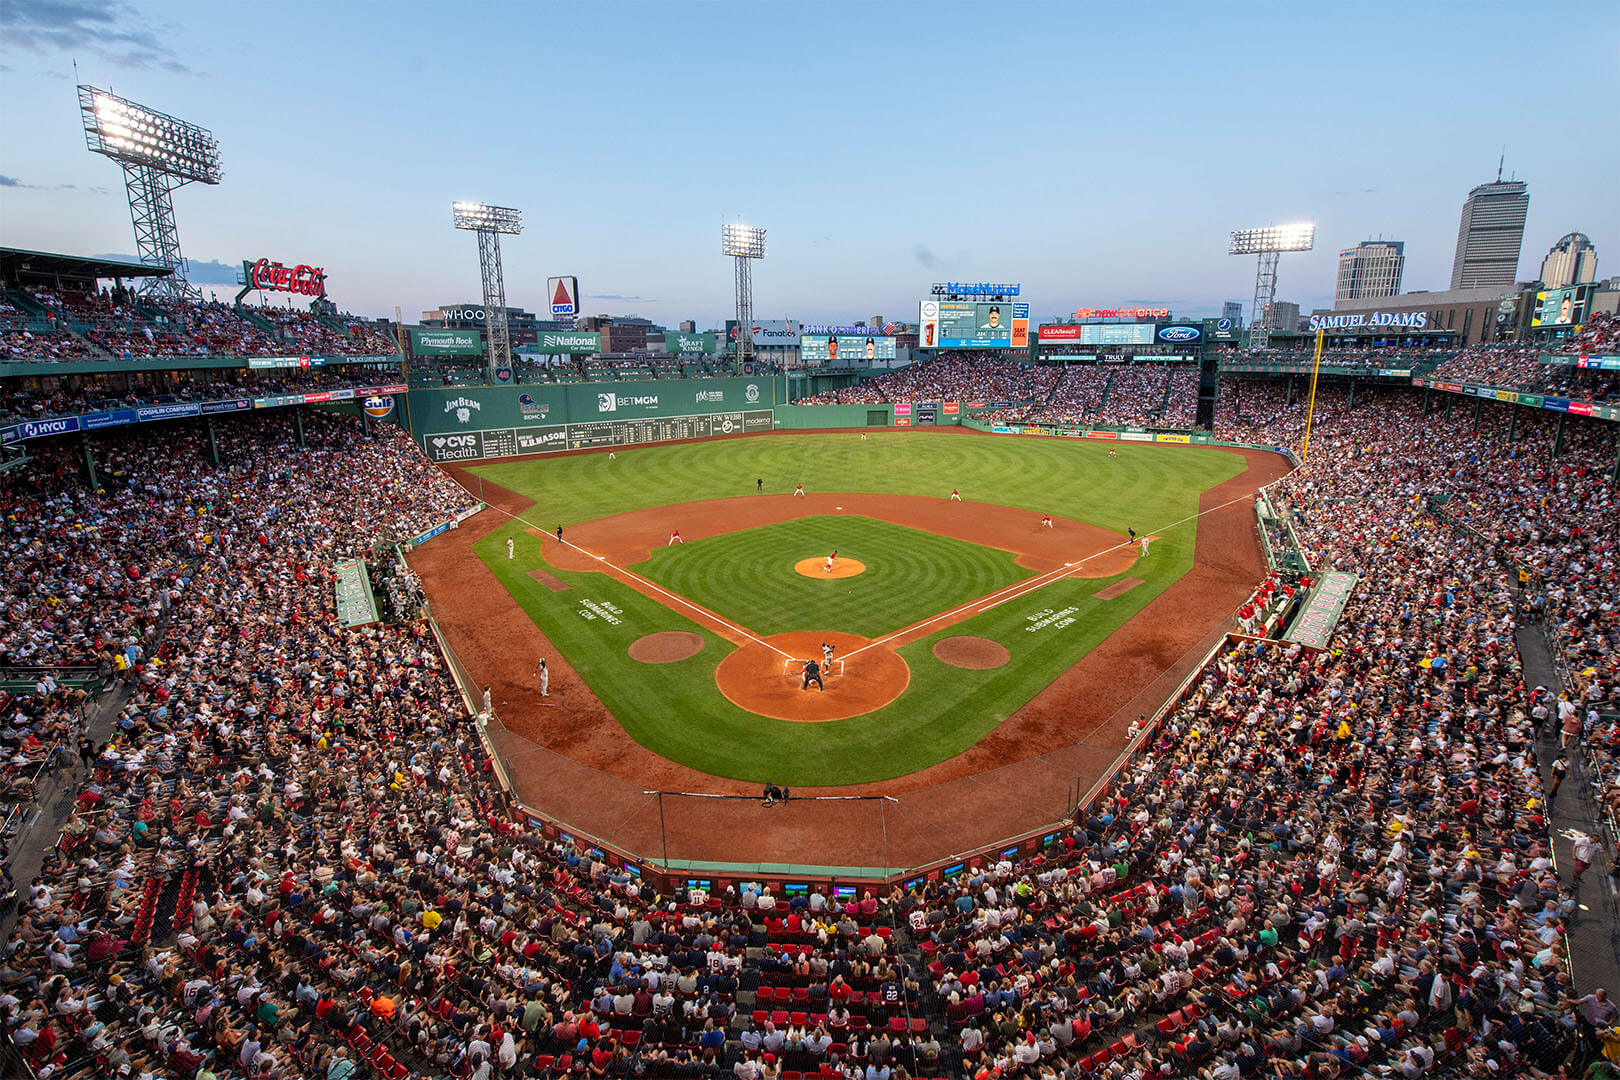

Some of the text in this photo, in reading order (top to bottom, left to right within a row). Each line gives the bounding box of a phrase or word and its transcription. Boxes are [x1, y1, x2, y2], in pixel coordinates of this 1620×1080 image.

[252, 257, 324, 296] Coca-Cola
[947, 282, 1020, 296] MassMutual
[552, 304, 573, 313] CITGO
[1094, 306, 1169, 318] new balance
[1309, 311, 1427, 331] SAMUEL ADAMS
[763, 328, 796, 337] Fanatics
[803, 325, 829, 334] BANK
[842, 326, 880, 334] AMERICA
[1166, 327, 1192, 339] Ford
[421, 336, 473, 346] Plymouth Rock
[556, 335, 596, 346] National
[363, 396, 394, 408] Gulf
[444, 397, 481, 413] JIM BEAM
[617, 395, 658, 406] BETMGM
[38, 420, 66, 433] HYCU
[447, 434, 476, 447] CVS
[435, 446, 478, 460] Health
[579, 598, 623, 626] SUBMARINES
[1291, 608, 1331, 644] BOSTON
[708, 958, 720, 968] 18
[703, 985, 710, 994] 2
[886, 990, 898, 1001] 22
